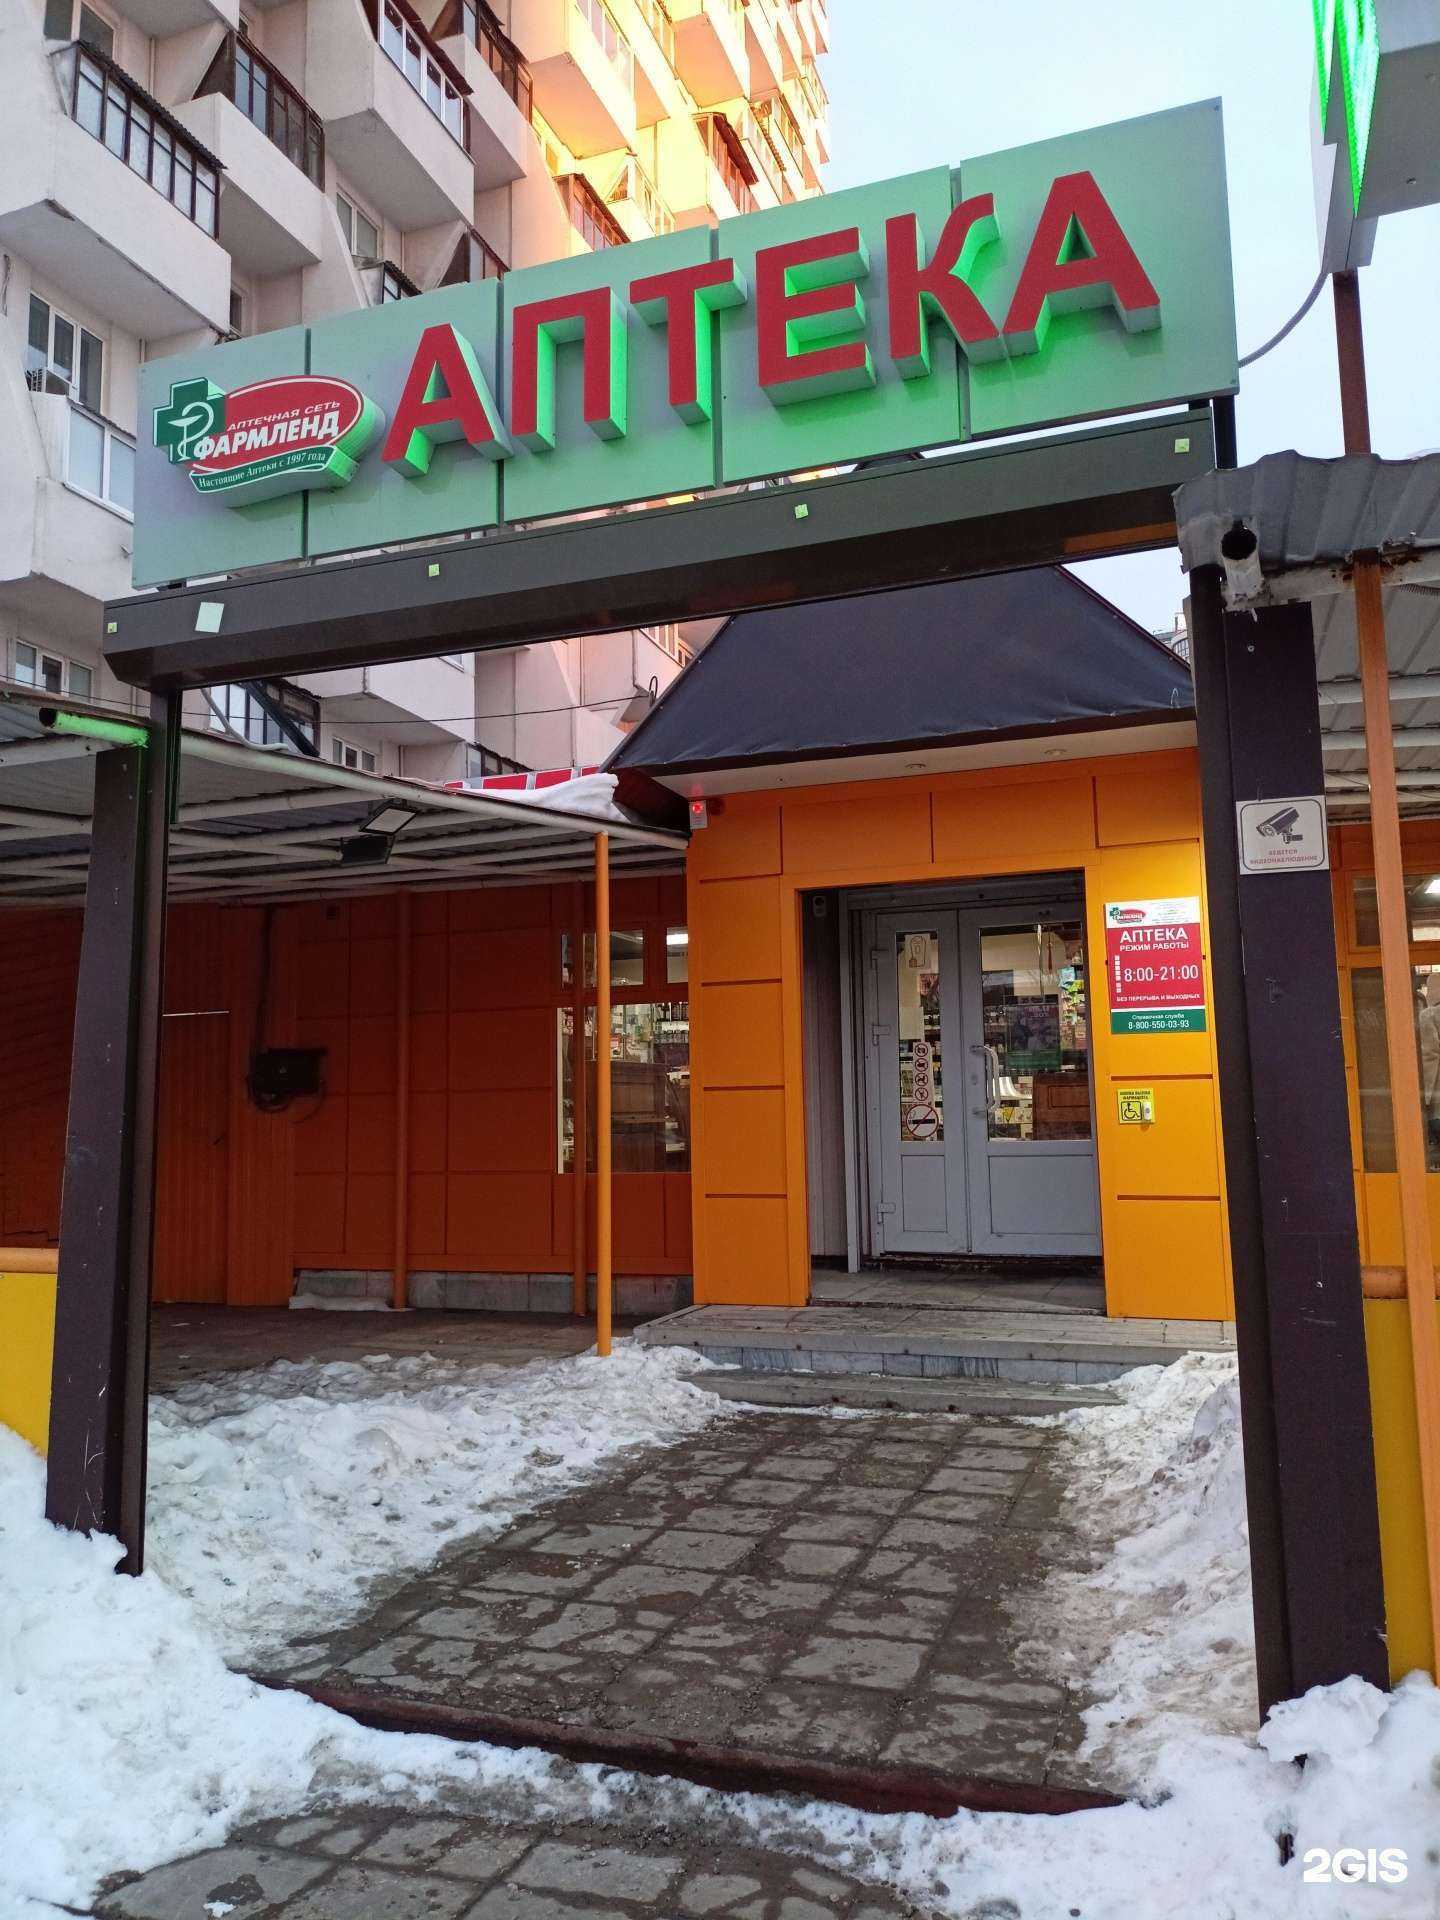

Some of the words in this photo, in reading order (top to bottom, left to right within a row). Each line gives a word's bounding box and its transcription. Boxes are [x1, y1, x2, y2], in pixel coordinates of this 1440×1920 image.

[383, 170, 1161, 468] АПТЕКА
[227, 410, 300, 431] АПТЕЧНАЯ
[304, 400, 341, 414] СЕТЬ
[193, 410, 340, 460] ФАРМЛЕНД
[199, 471, 245, 487] Настоящие
[246, 461, 278, 477] Аптеки
[286, 452, 307, 465] 1997
[307, 452, 326, 462] года
[1119, 927, 1189, 944] АПТЕКА
[1119, 944, 1151, 952] РЕЖИМ
[1152, 941, 1189, 950] РАБОТЫ
[1123, 964, 1199, 982] 8:00-21:00
[1128, 994, 1160, 1002] ПЕРЕРЫВА
[1166, 993, 1201, 1001] ВЫХОДНЫХ
[1128, 1019, 1190, 1030] 8-800-550-03-93
[1131, 1012, 1164, 1021] Справочная
[1164, 1012, 1185, 1021] служба
